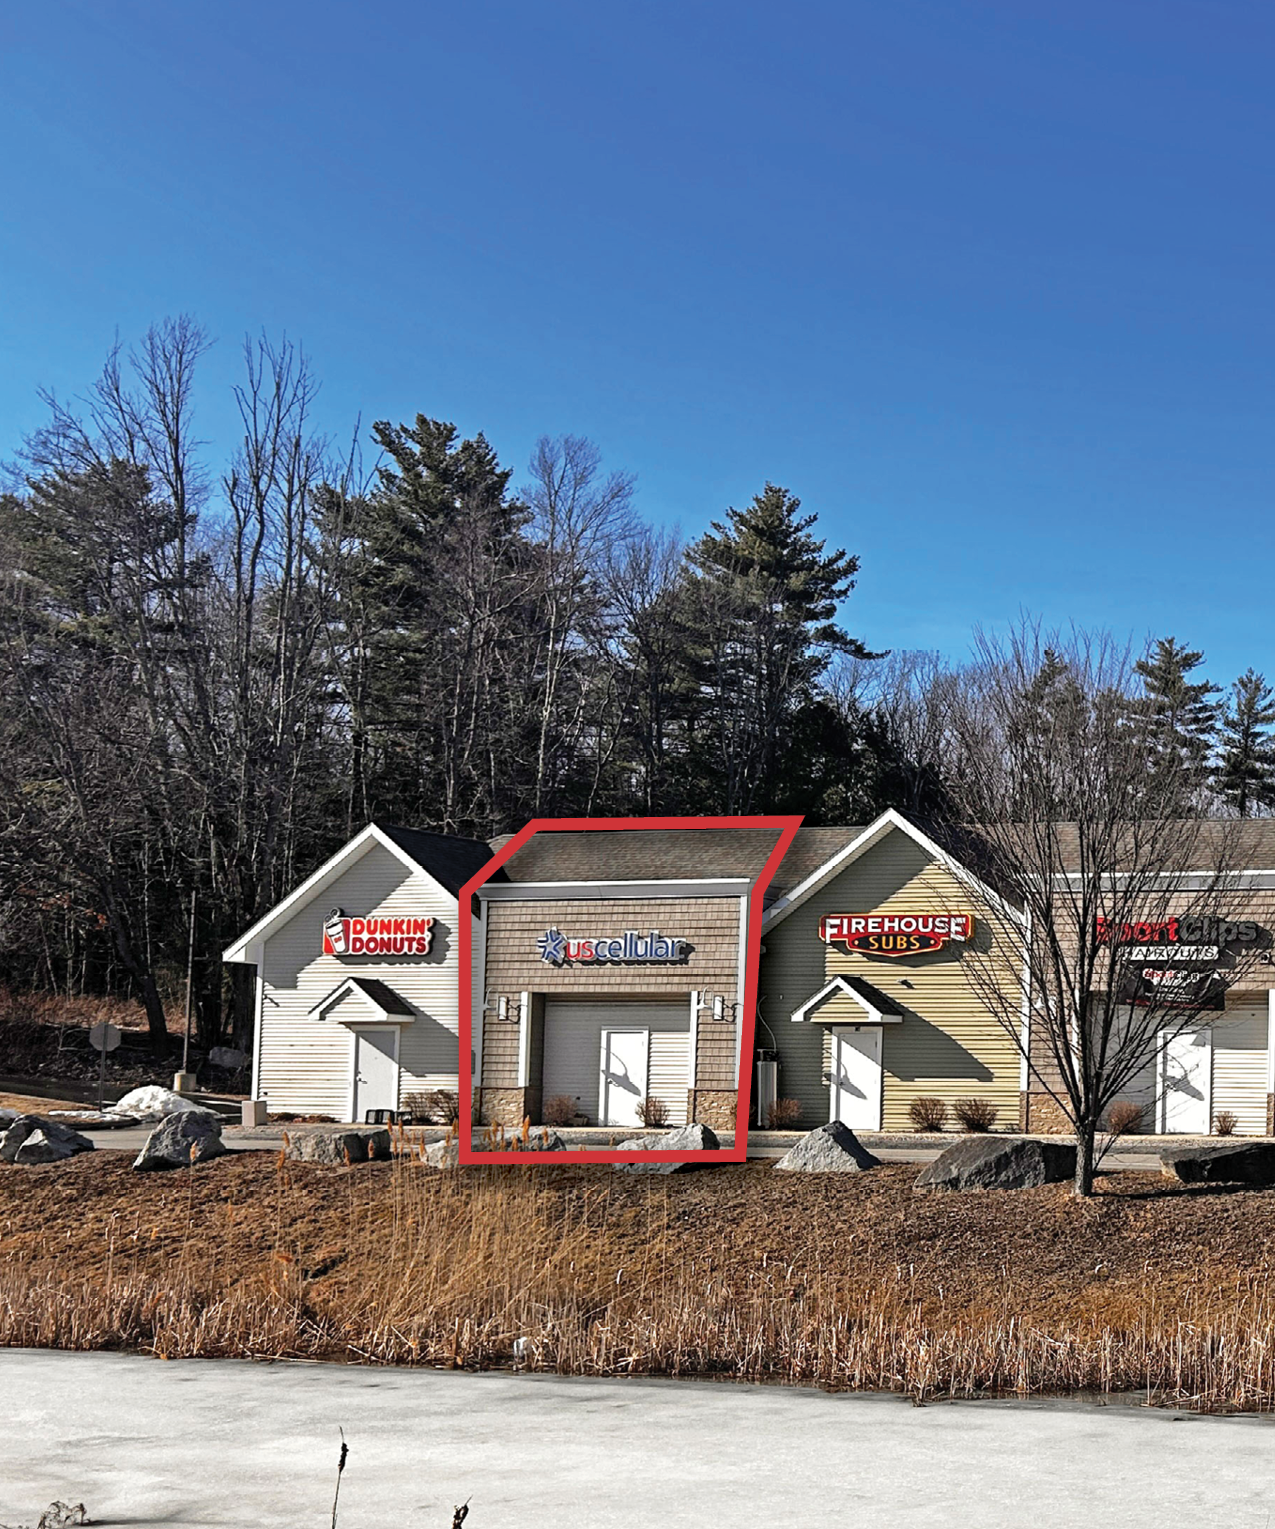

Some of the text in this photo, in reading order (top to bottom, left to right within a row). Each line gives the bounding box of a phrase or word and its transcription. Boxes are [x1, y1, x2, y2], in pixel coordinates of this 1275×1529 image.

[352, 918, 432, 935] DUNKIN'
[825, 917, 966, 942] FIREHOUSE
[352, 936, 427, 953] DONUTS
[566, 931, 685, 959] uscellular
[869, 935, 920, 949] SUBS
